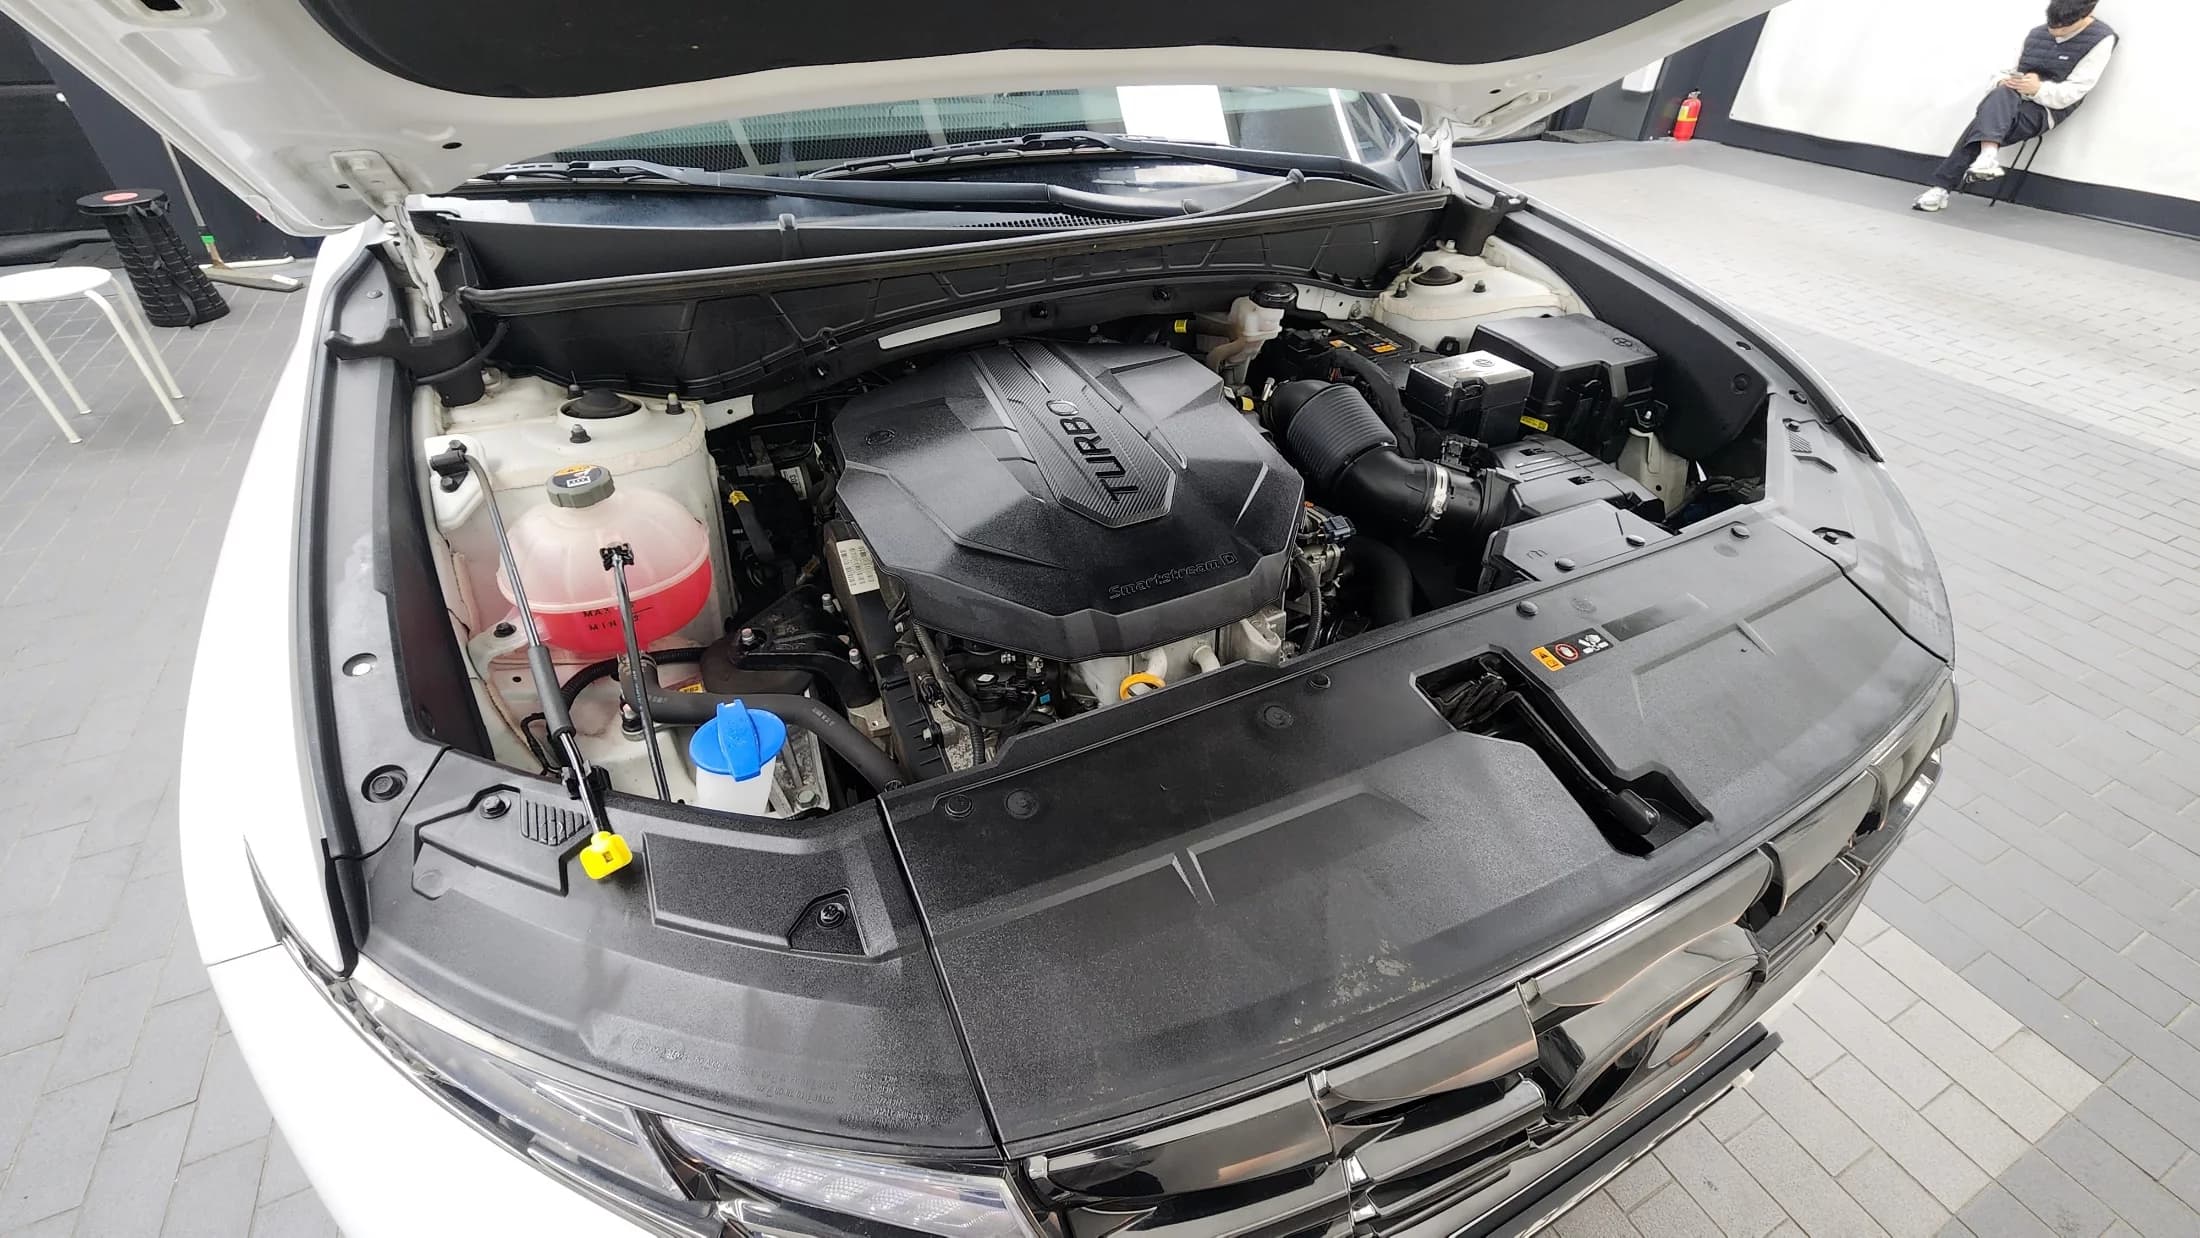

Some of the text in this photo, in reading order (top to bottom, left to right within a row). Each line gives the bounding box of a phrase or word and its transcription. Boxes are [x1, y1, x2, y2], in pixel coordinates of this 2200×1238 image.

[1046, 400, 1138, 503] TURBO
[1108, 559, 1220, 599] Smartstream
[589, 620, 617, 631] MIN
